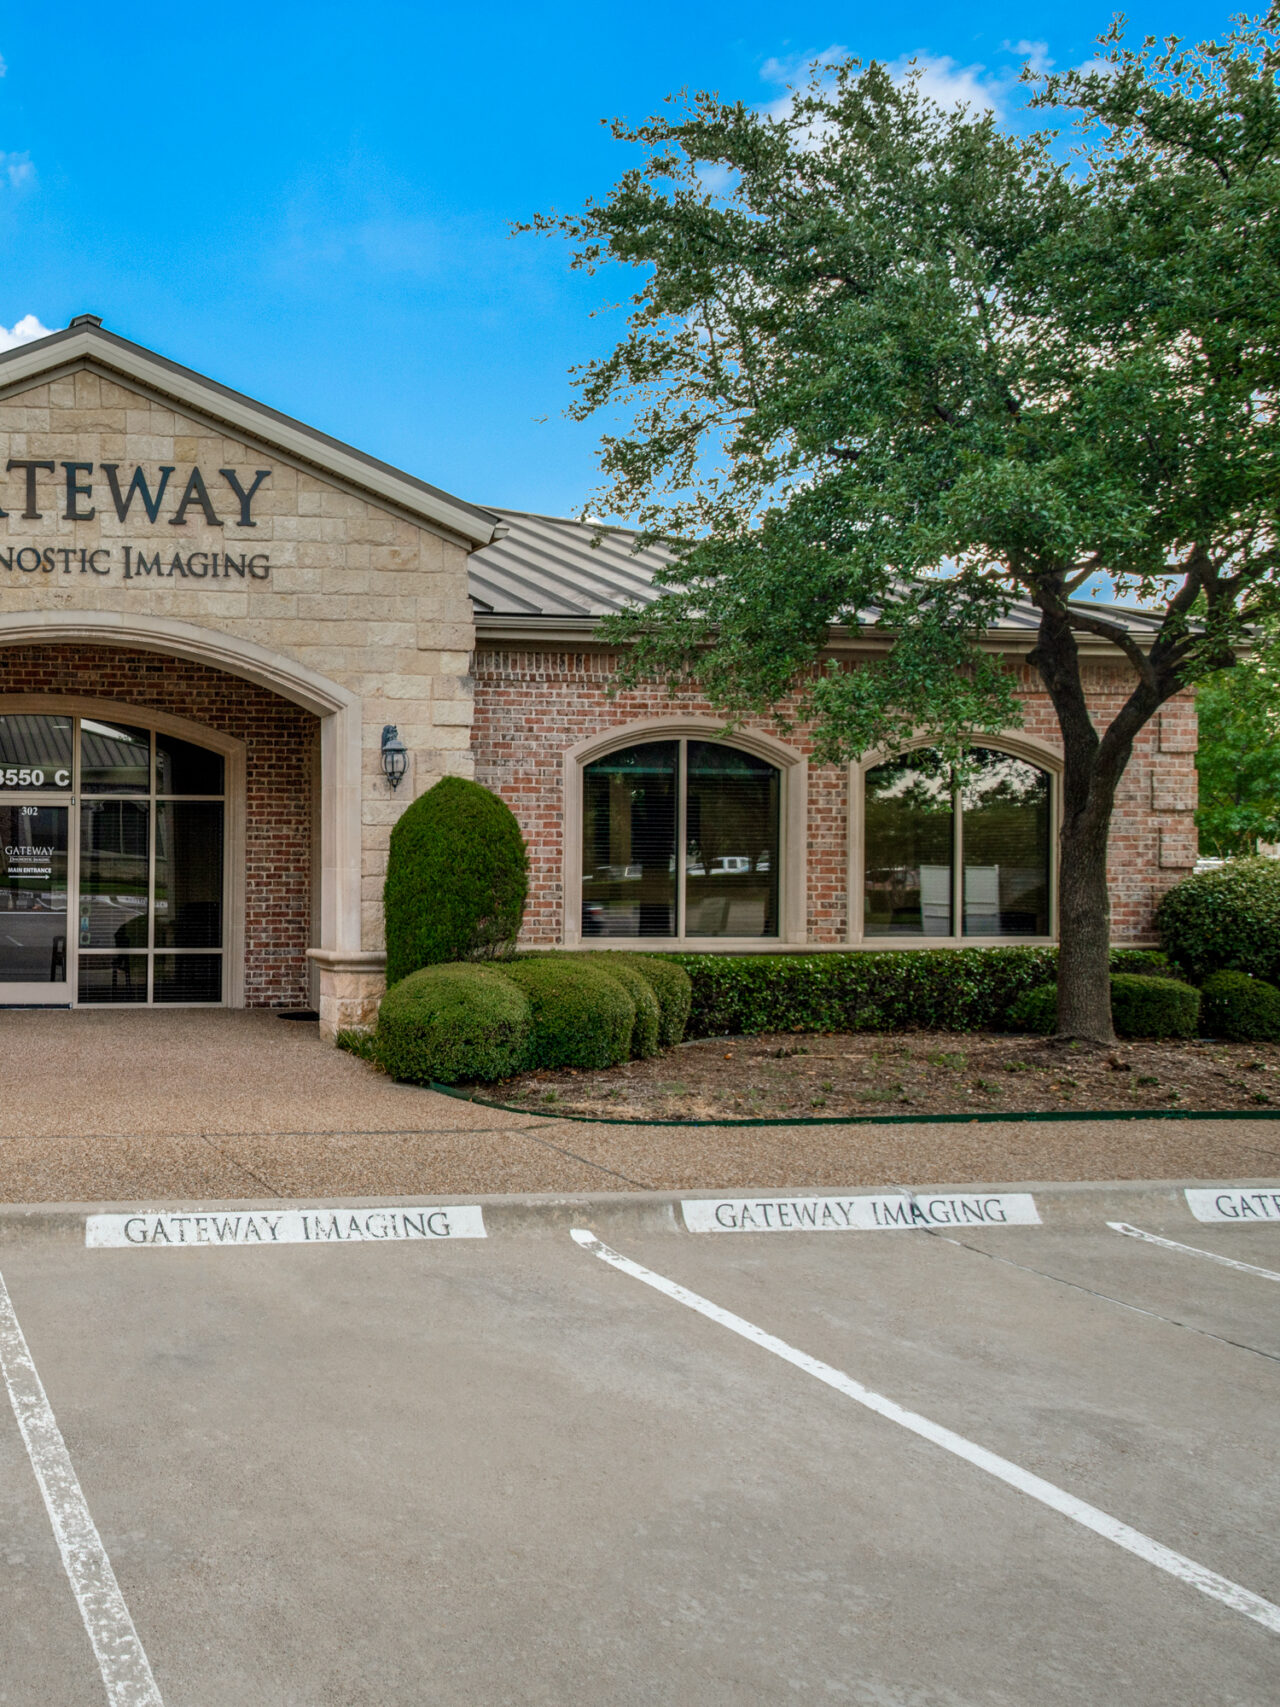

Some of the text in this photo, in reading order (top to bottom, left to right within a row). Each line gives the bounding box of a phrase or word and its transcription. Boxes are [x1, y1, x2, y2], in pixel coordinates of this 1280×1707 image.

[122, 546, 271, 580] IMAGING
[54, 769, 70, 787] C
[21, 806, 39, 816] 302
[4, 845, 55, 856] GATEWAY
[715, 1198, 1007, 1226] GATEWAY IMAGING
[124, 1211, 451, 1244] GATEWAY IMAGING
